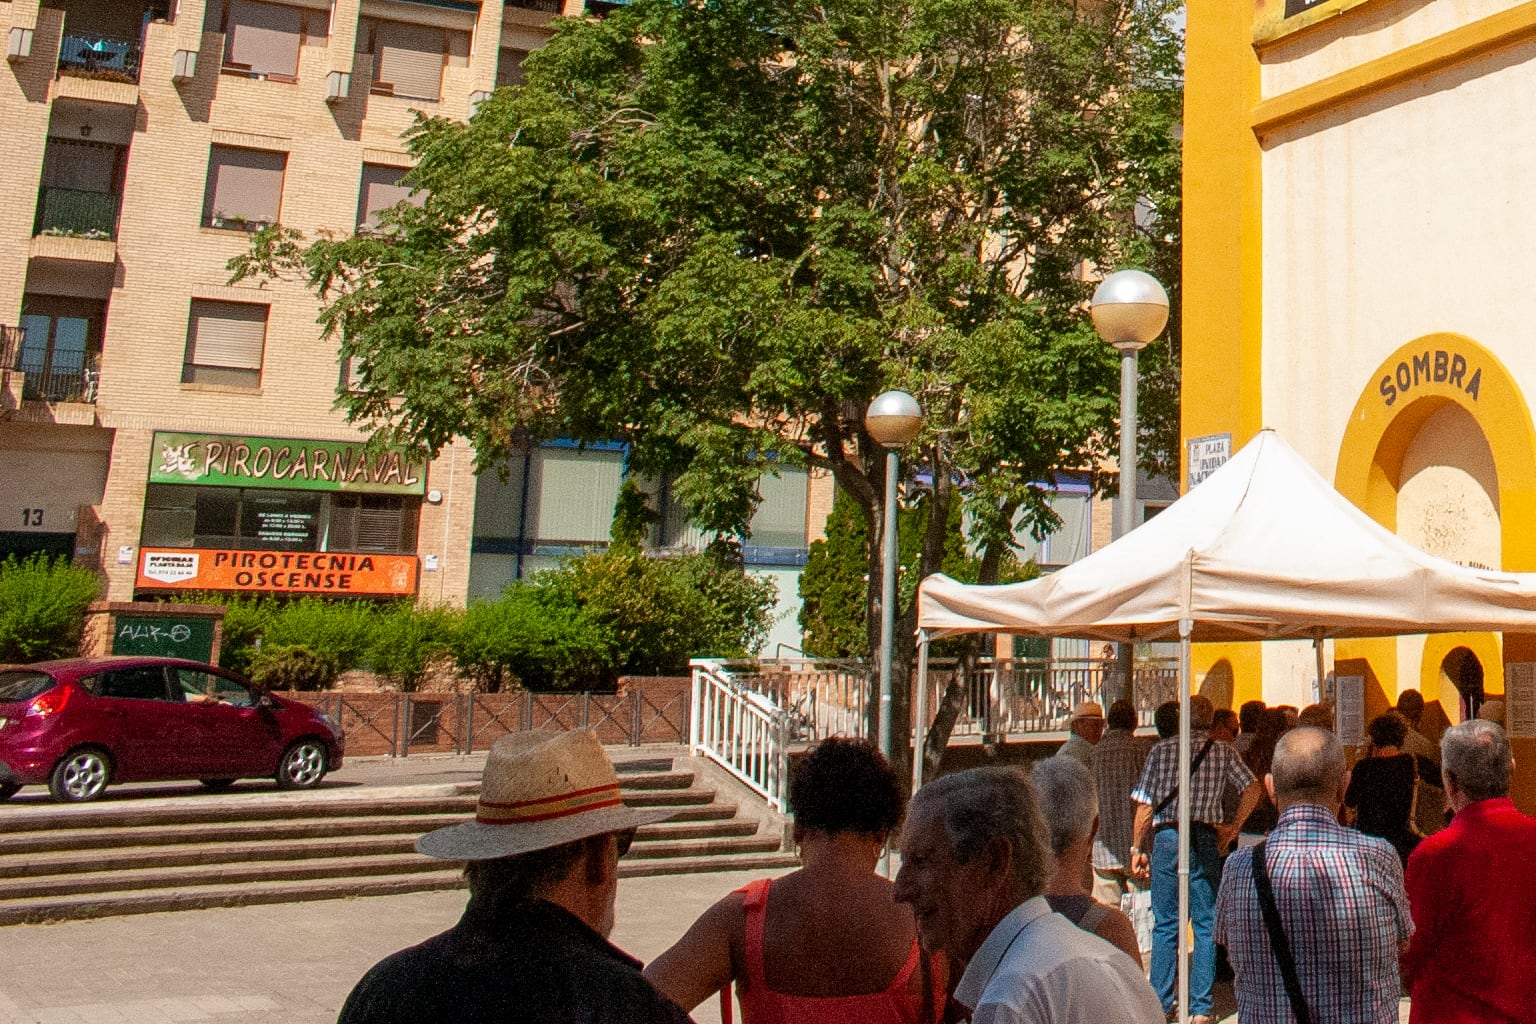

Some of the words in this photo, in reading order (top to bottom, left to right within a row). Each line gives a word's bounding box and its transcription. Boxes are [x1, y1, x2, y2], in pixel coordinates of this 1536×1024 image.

[1379, 350, 1482, 407] SOMBRA
[1205, 441, 1225, 455] PLAZA
[202, 442, 419, 486] PIROCARNAVAL
[22, 508, 44, 526] 13
[214, 552, 375, 572] PIROTECNIA
[234, 571, 352, 589] OSCENSE
